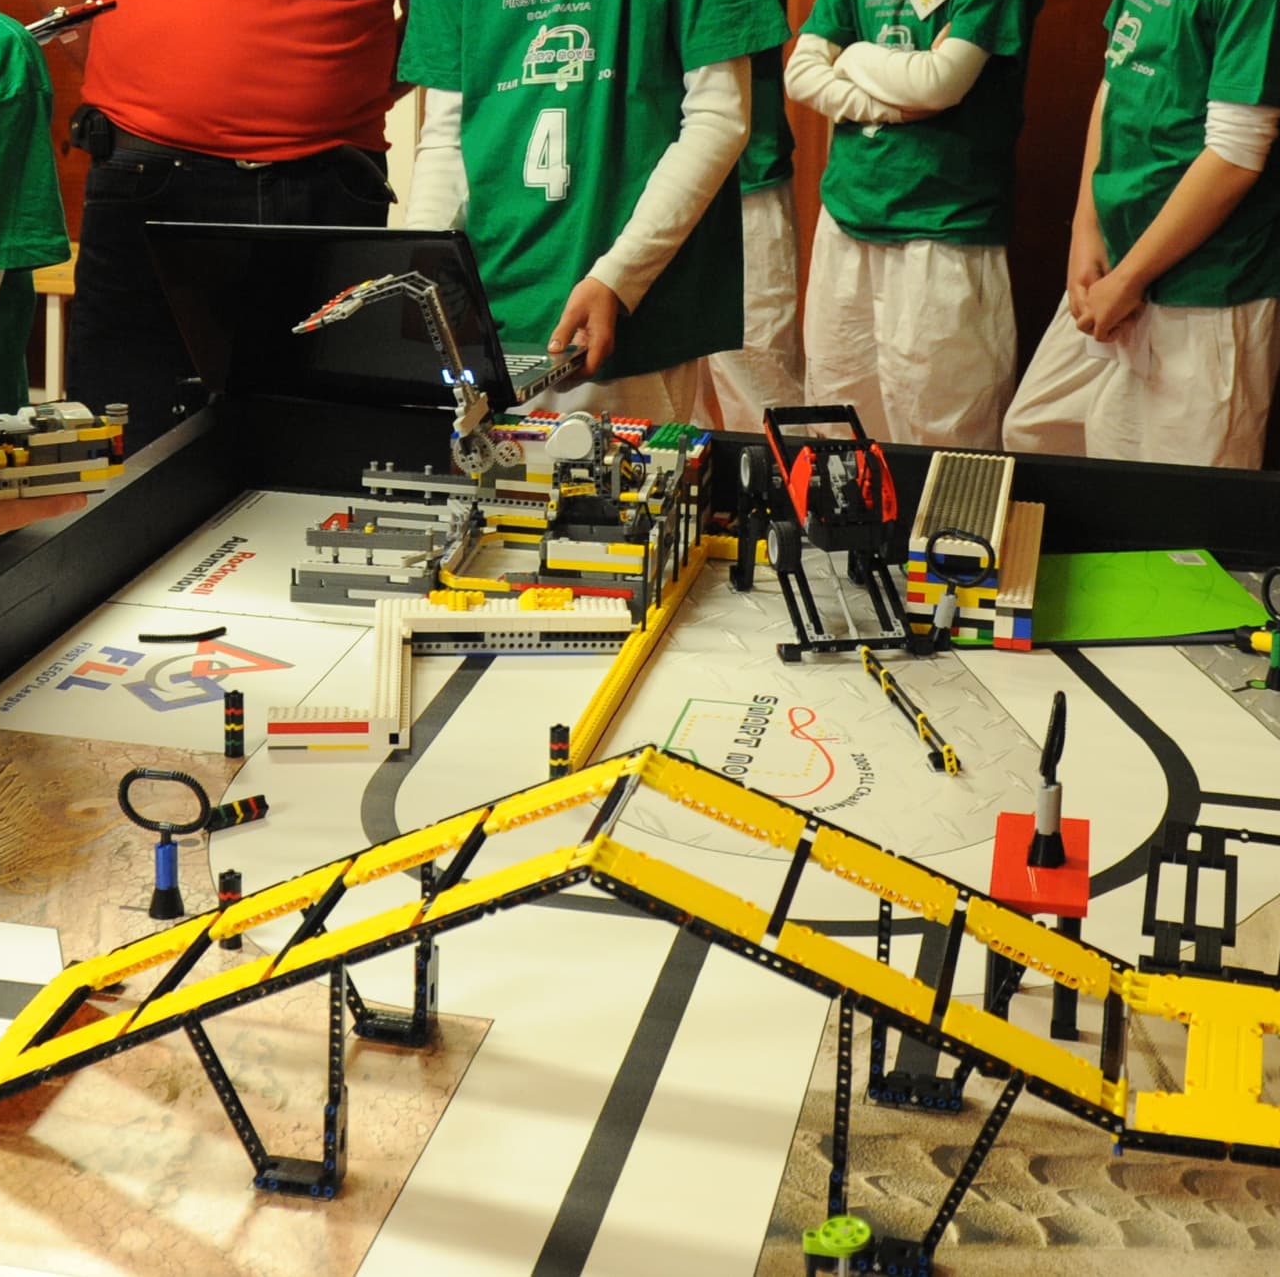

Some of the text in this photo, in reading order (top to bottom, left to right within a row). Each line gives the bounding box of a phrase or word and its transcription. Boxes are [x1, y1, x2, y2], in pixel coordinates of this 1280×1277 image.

[1131, 62, 1156, 77] 2009
[523, 108, 571, 202] 4
[168, 535, 249, 593] Automation
[191, 551, 257, 596] Rockwell
[55, 646, 146, 691] FLL
[66, 641, 93, 663] FIRST
[734, 694, 779, 748] SMART
[850, 753, 872, 773] 2009
[860, 772, 875, 785] FLL
